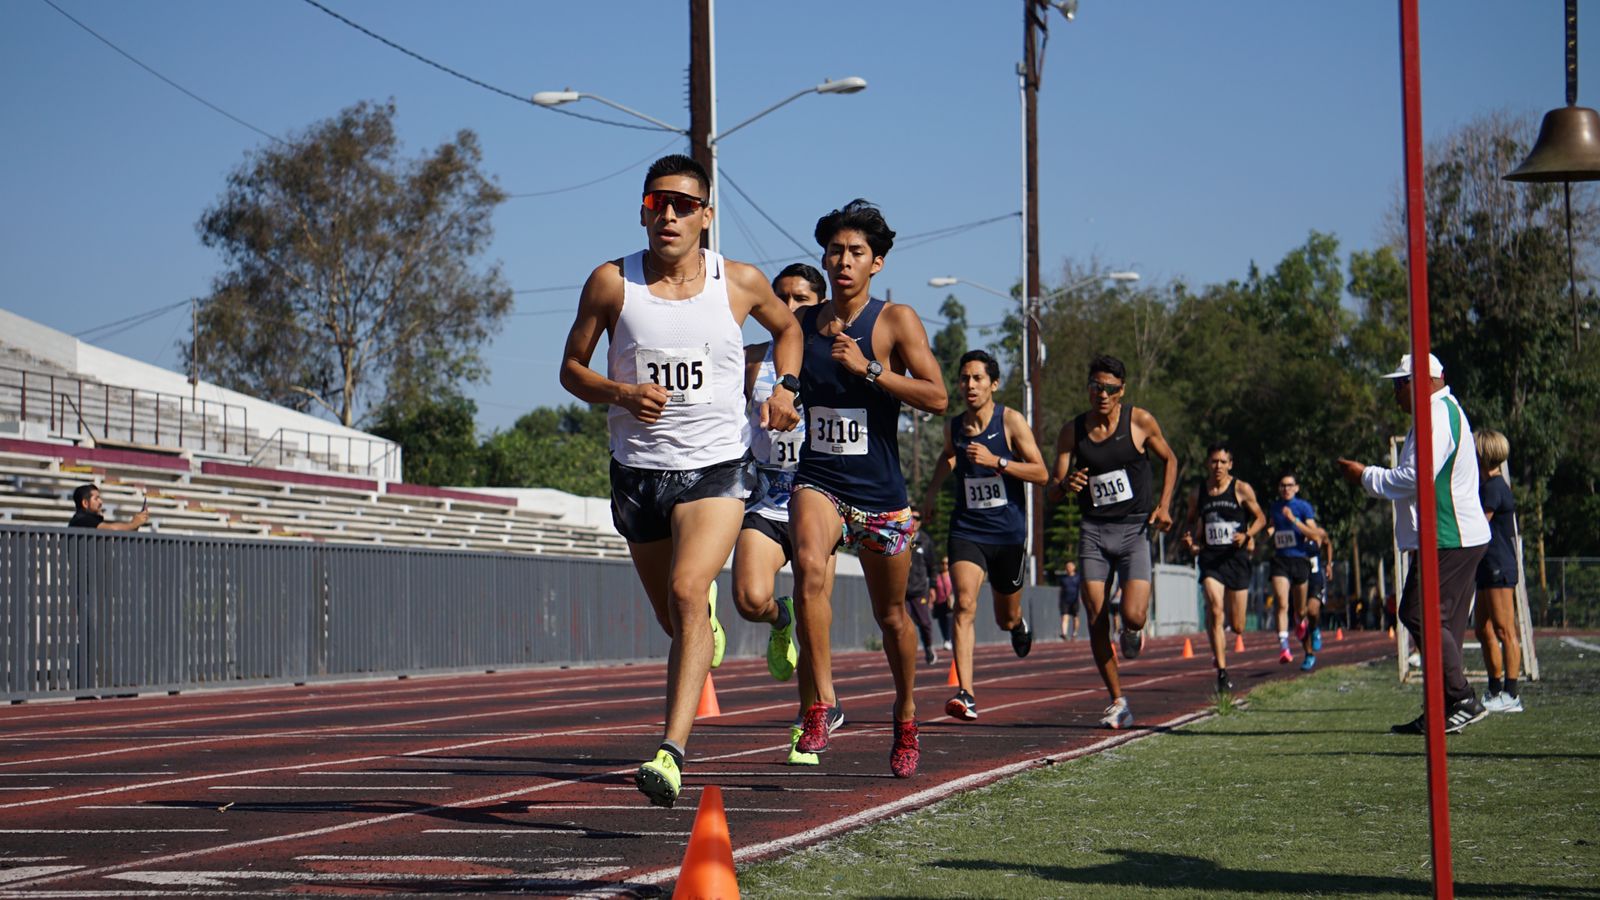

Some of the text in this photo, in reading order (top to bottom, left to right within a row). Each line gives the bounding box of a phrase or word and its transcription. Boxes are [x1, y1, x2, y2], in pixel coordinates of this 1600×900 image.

[646, 361, 703, 391] 3105
[817, 417, 859, 443] 3110
[969, 483, 1000, 501] 3138
[1094, 478, 1125, 499] 3116
[1208, 528, 1229, 540] 3104
